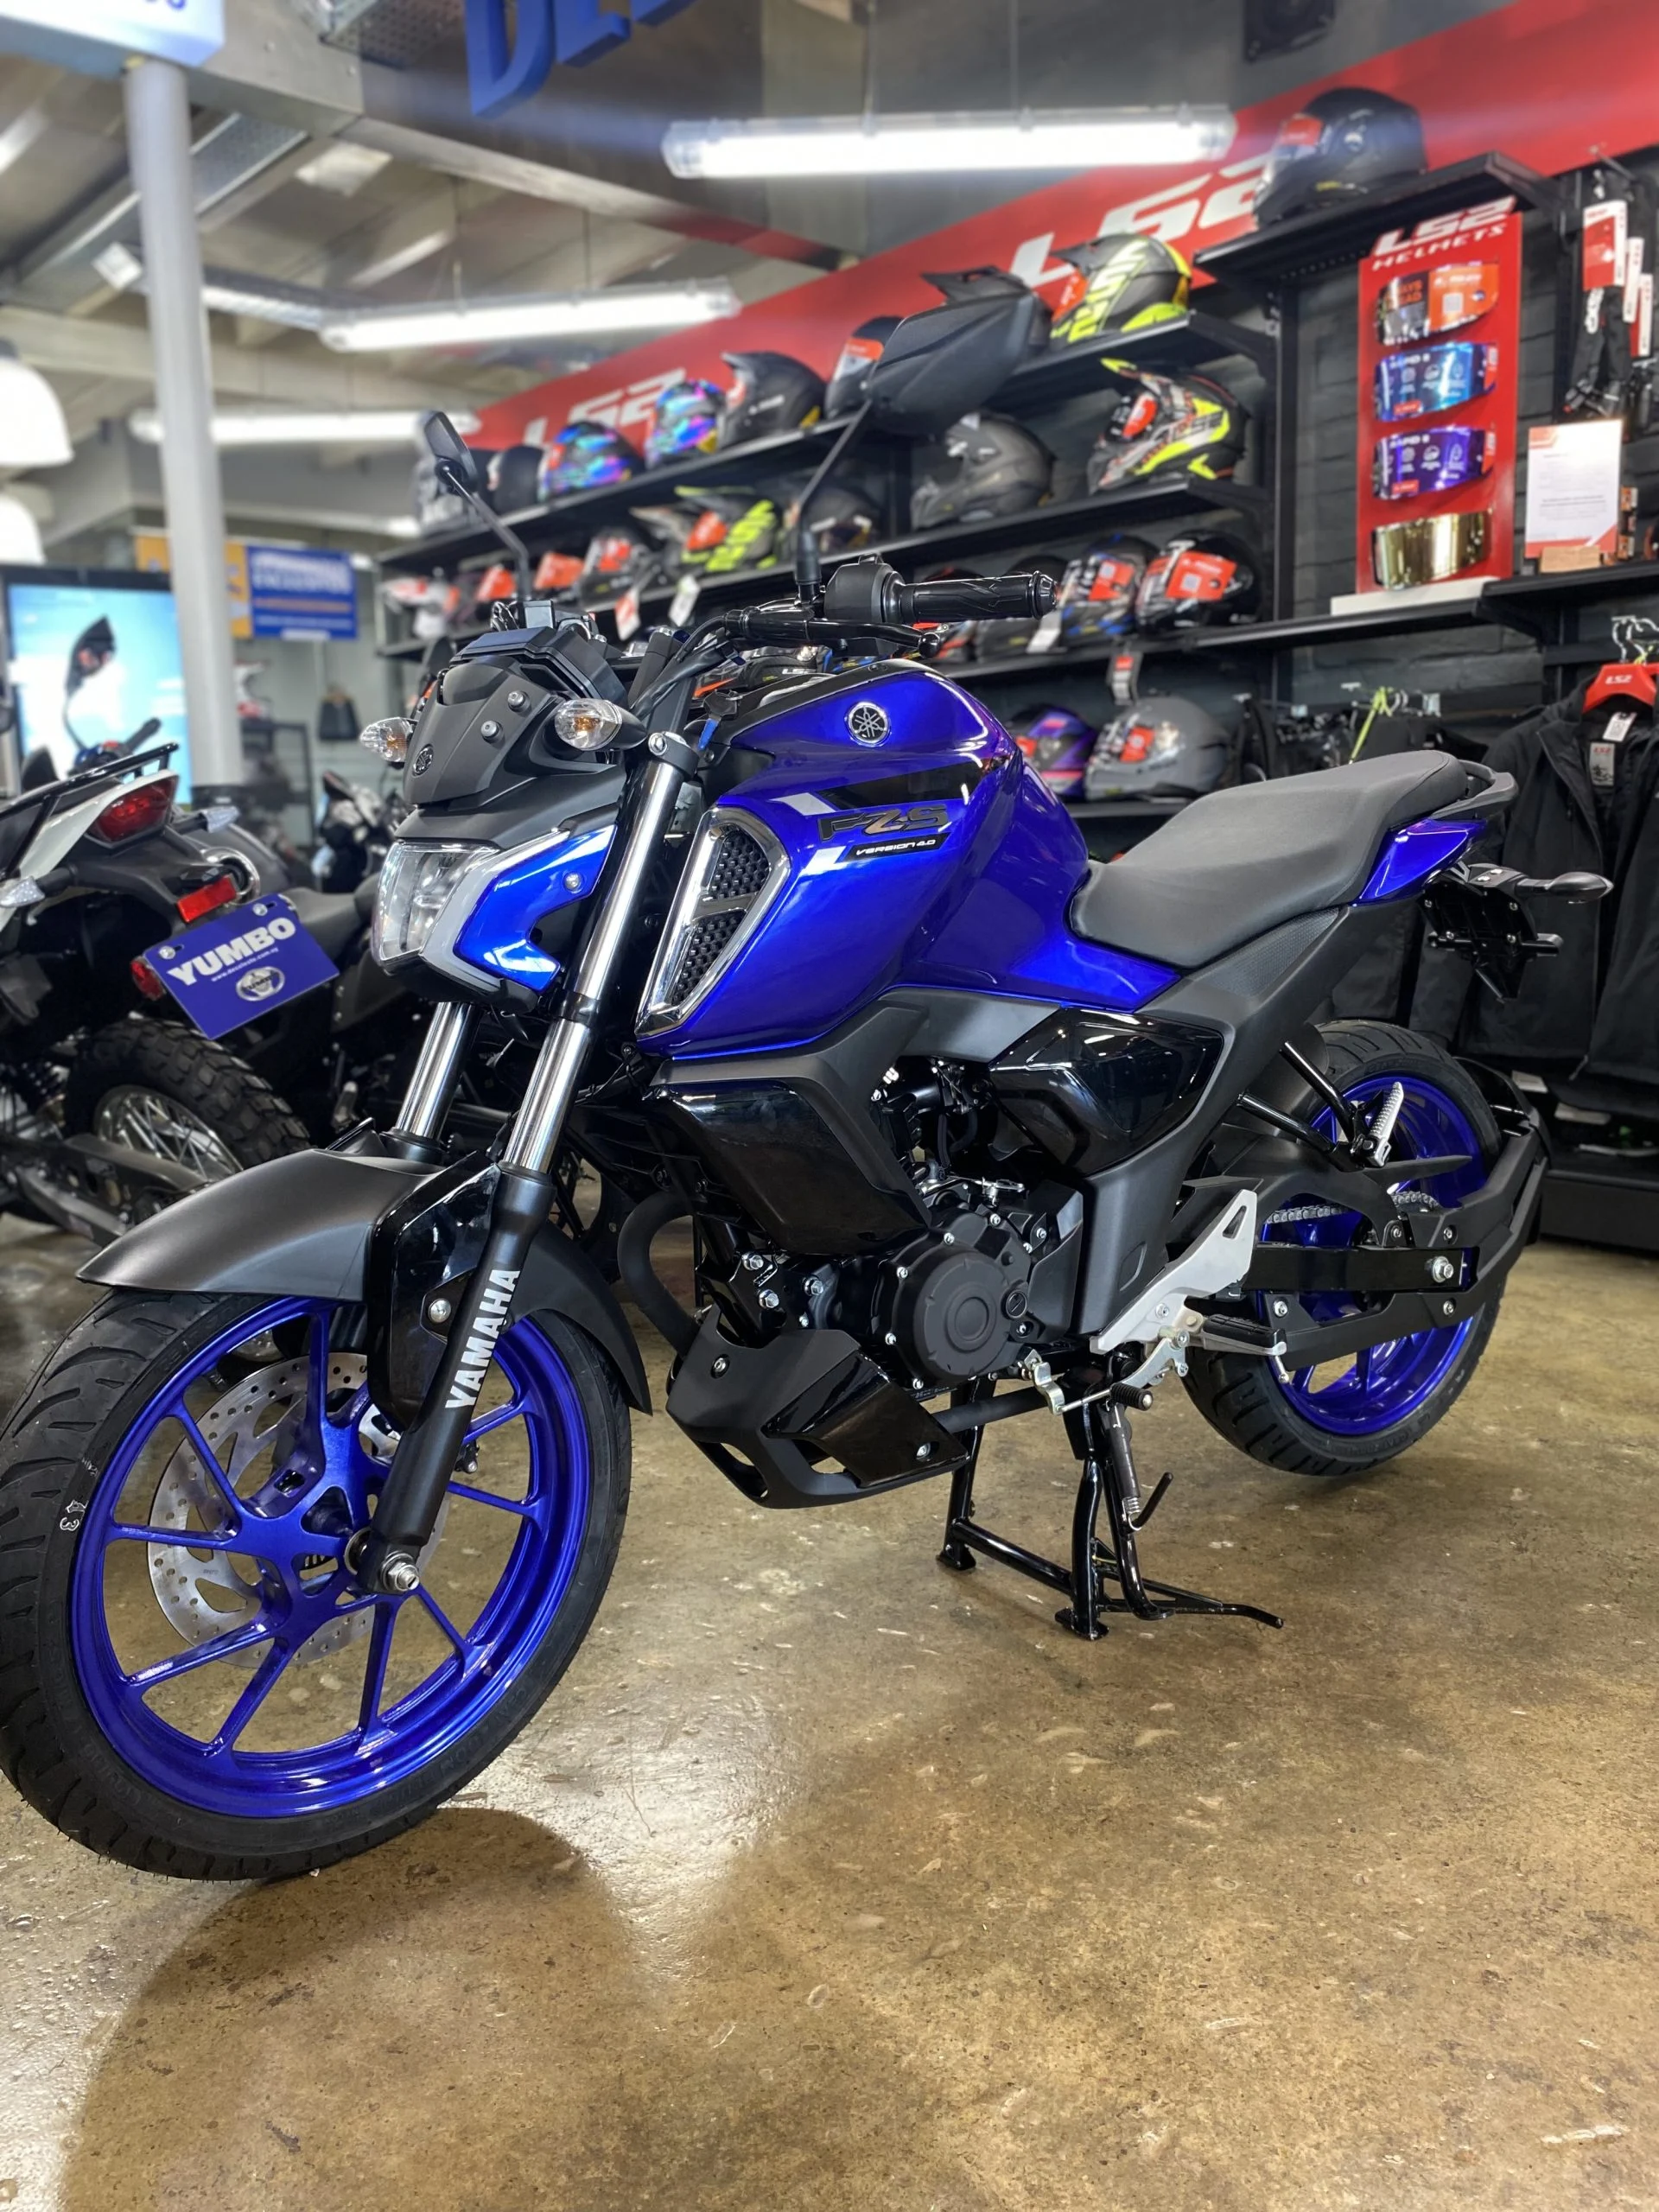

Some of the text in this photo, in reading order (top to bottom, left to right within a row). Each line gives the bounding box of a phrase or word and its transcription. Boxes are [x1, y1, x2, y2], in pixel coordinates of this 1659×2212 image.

[1372, 224, 1507, 272] HELMETS
[1374, 195, 1516, 257] LS2
[1605, 675, 1633, 684] LS2
[855, 842, 915, 855] VERSION
[166, 917, 296, 987] YUMBO
[444, 1269, 521, 1408] YAMAHA
